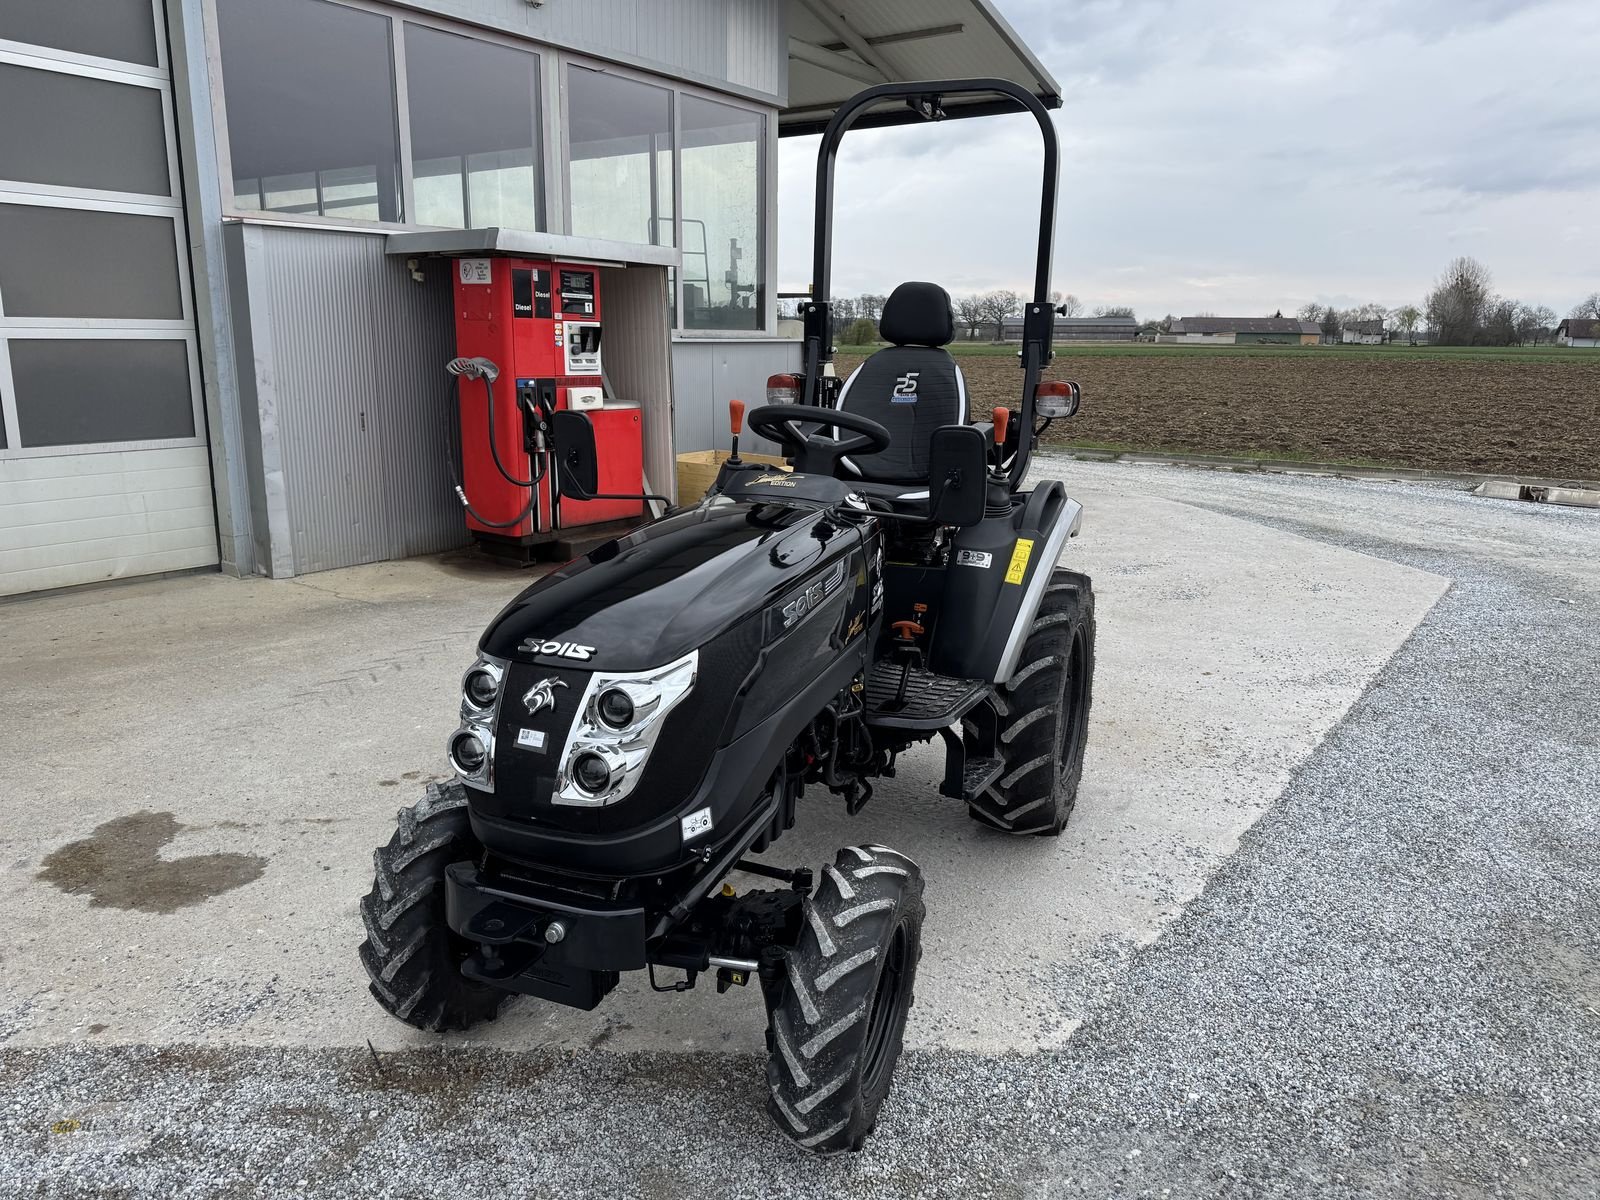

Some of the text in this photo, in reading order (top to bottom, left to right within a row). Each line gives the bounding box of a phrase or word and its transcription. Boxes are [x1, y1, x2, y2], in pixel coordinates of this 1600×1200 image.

[535, 290, 551, 298] Diesel
[515, 303, 532, 311] Diesel
[586, 304, 592, 312] 1
